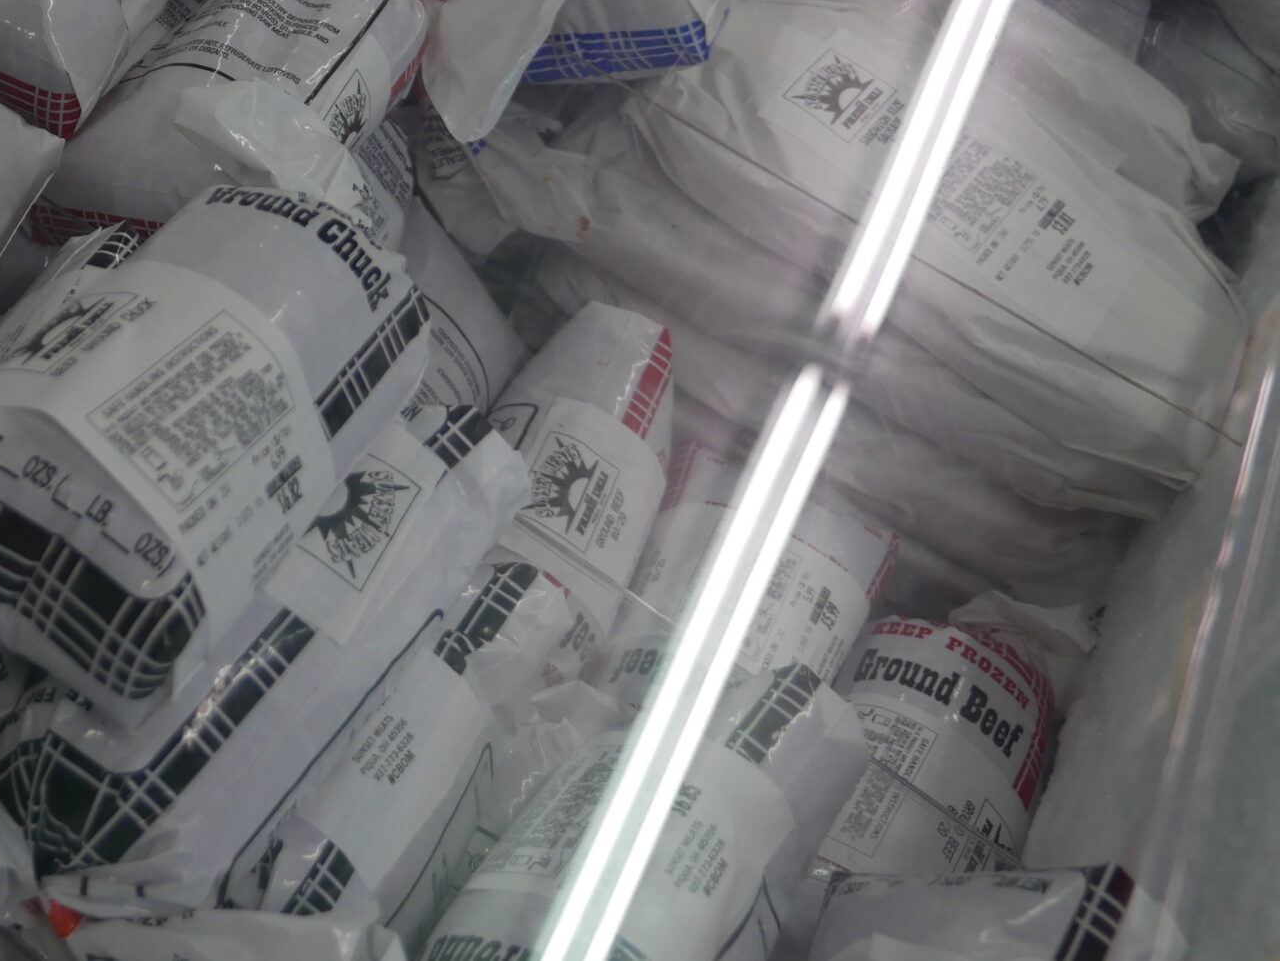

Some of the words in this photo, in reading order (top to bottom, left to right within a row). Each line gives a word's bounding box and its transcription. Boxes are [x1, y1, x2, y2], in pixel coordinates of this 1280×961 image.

[884, 96, 904, 116] SIZE
[320, 206, 397, 314] Chuck
[119, 292, 158, 325] CHUCK
[592, 512, 618, 548] GROUND
[606, 487, 627, 512] BEEF
[131, 529, 177, 577] OZS.)
[871, 619, 933, 639] KEEP
[944, 636, 1030, 709] FROZEN
[853, 648, 952, 705] Ground
[960, 685, 1026, 760] Beef
[350, 733, 376, 764] SUNSET
[370, 711, 394, 738] MEATS
[377, 738, 391, 753] OH
[385, 715, 408, 742] 45356
[915, 736, 929, 755] SAFE
[869, 788, 900, 842] INSTRUCTIONS
